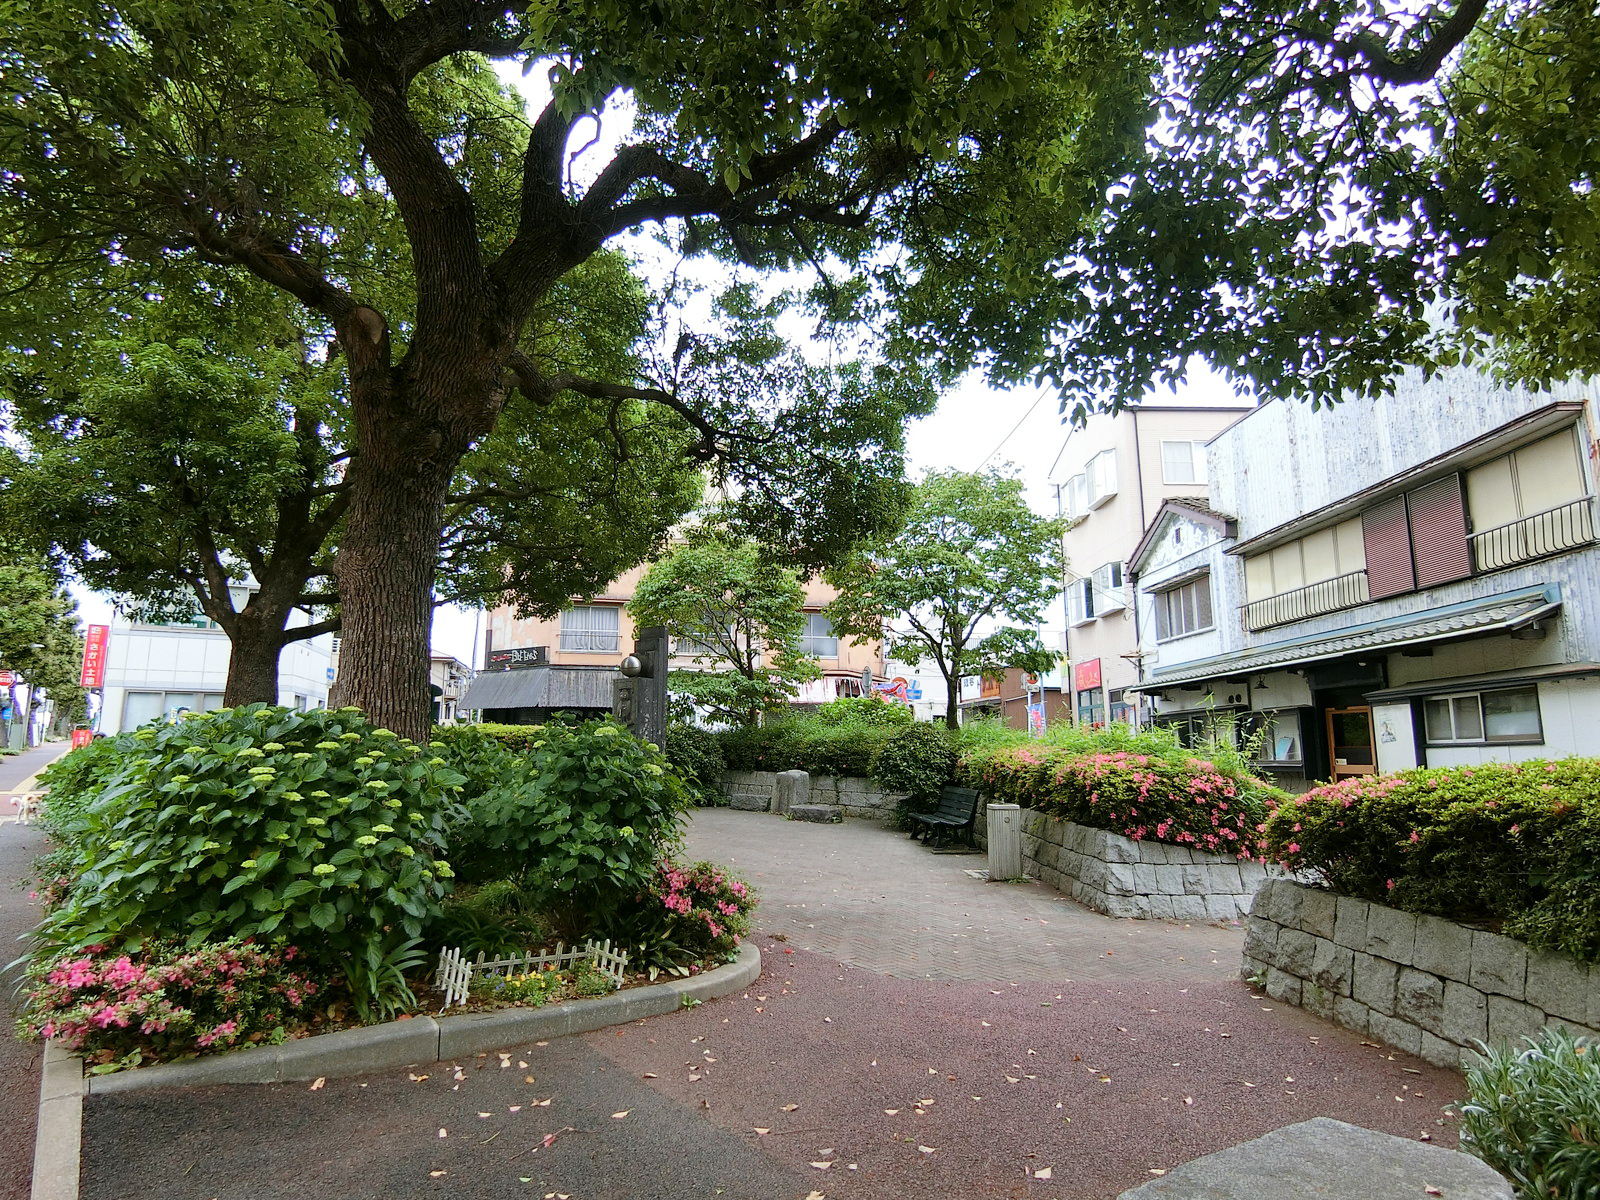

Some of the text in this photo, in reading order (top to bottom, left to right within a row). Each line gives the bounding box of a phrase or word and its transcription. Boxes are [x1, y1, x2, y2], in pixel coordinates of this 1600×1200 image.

[84, 643, 99, 685] さかい土地
